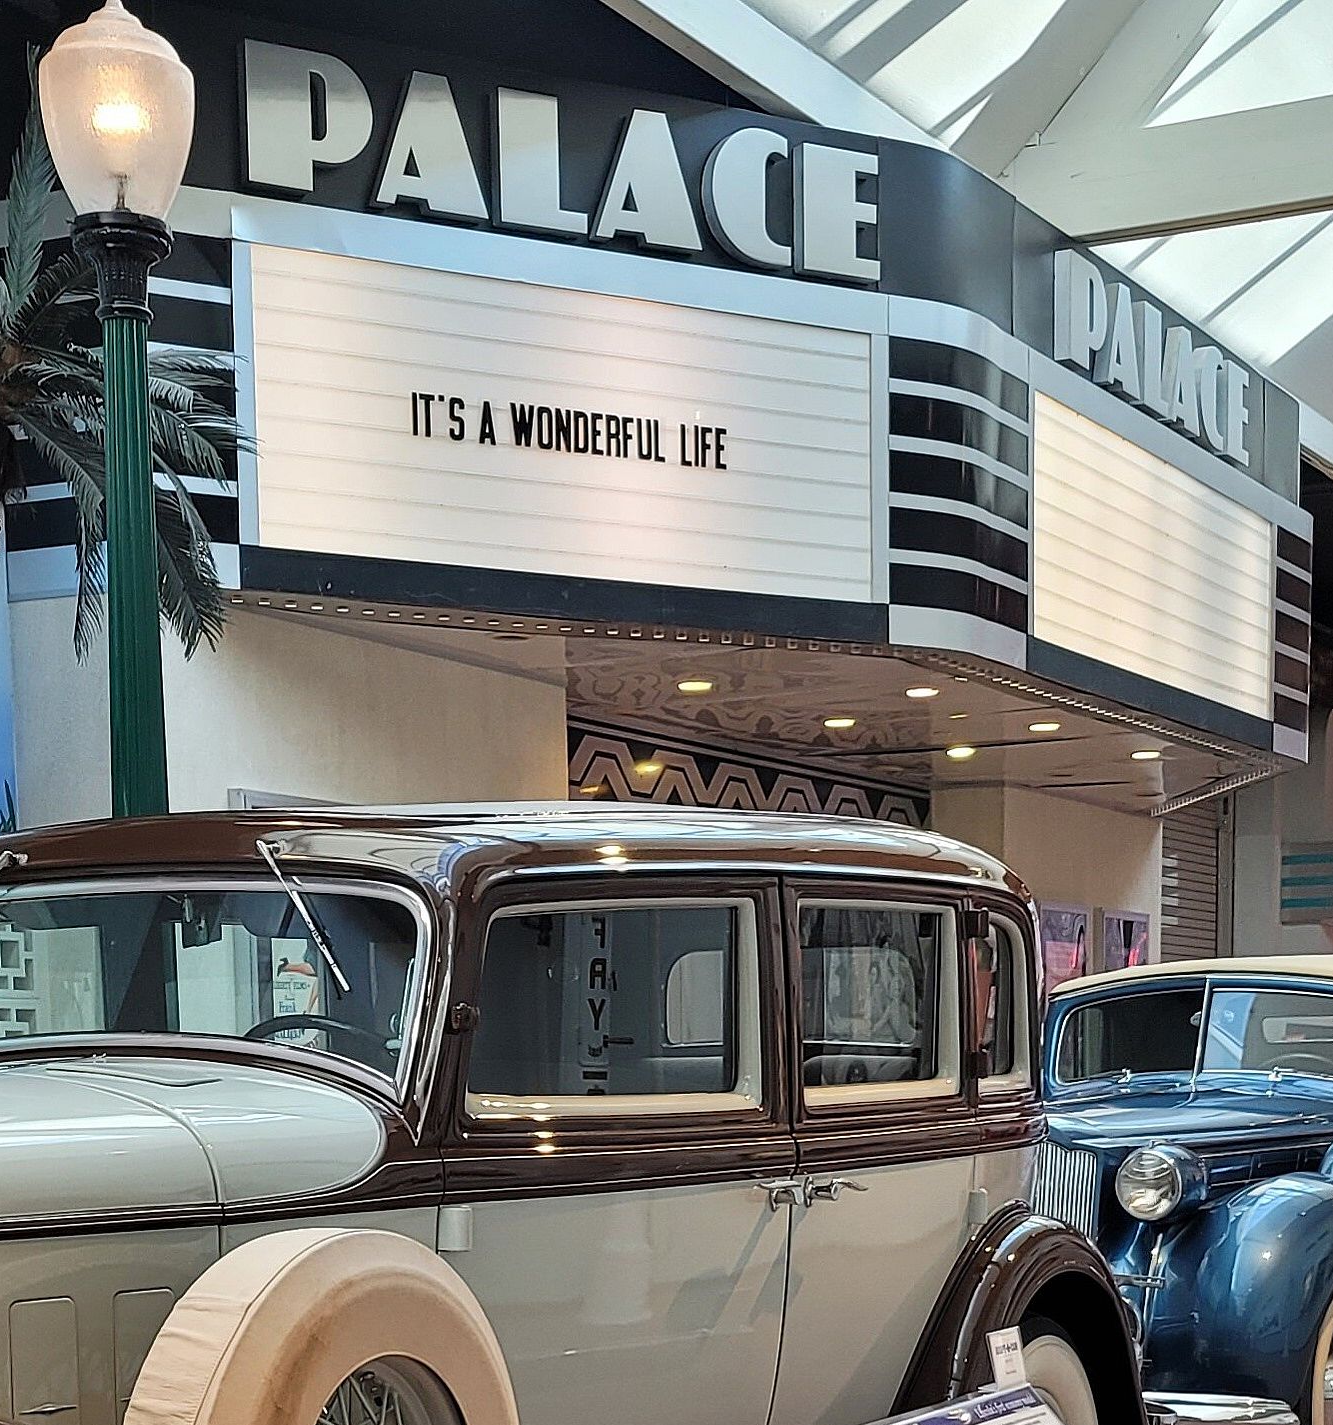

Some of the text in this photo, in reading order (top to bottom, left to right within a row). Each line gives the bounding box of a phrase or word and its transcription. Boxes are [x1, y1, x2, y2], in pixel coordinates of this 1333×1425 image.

[243, 38, 881, 282] PALACE
[411, 391, 728, 470] IT'S A WONDERFUL LIFE
[1054, 249, 1250, 467] PALACE
